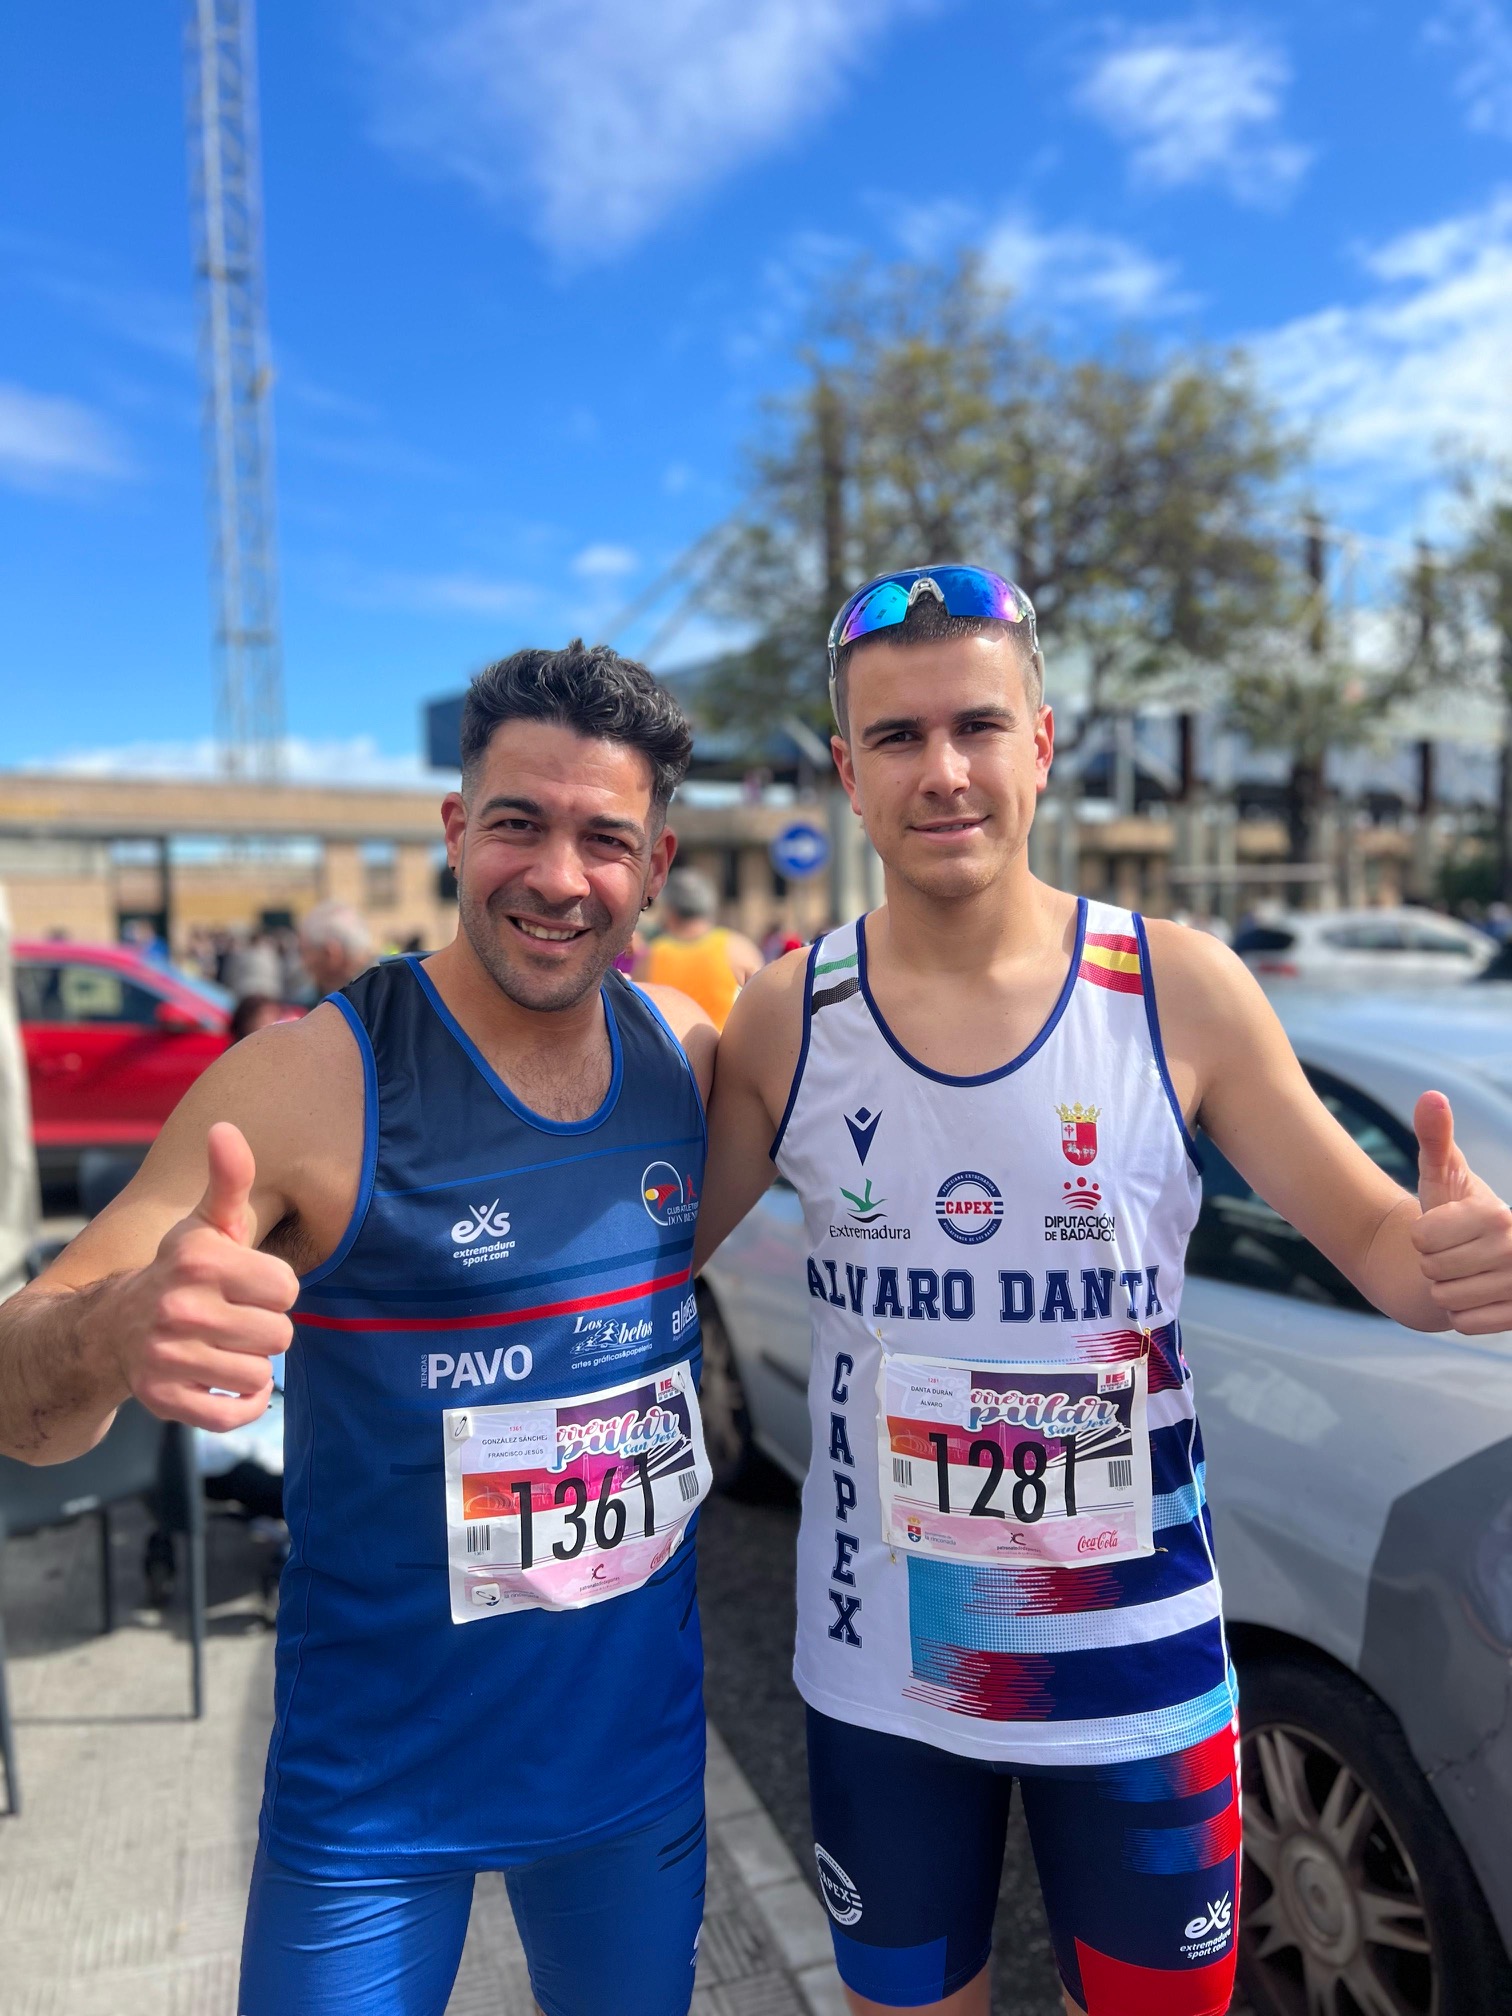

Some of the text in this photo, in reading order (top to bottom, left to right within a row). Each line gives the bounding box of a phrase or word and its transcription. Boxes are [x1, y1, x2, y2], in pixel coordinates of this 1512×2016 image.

[945, 1201, 994, 1215] CAPEX
[1044, 1212, 1115, 1229] DIPUTACIÓN
[829, 1224, 911, 1240] Extremadura
[1044, 1231, 1057, 1241] DE
[453, 1240, 516, 1259] extremadura
[462, 1250, 510, 1268] sport.com
[998, 1265, 1164, 1323] DANTA
[572, 1316, 603, 1334] Los
[420, 1345, 533, 1390] TIENDAS PAVO
[571, 1360, 592, 1370] artes
[910, 1385, 954, 1397] DANTA DURÁN
[920, 1399, 943, 1408] ÁLVARO
[1047, 1425, 1077, 1436] San
[481, 1436, 517, 1446] GONZÁLEZ
[623, 1443, 647, 1455] San
[488, 1448, 544, 1459] FRANCISCO JESÚS
[929, 1432, 1077, 1523] 1281
[511, 1455, 655, 1571] 1361
[1180, 1928, 1231, 1952] extremadura
[1187, 1940, 1227, 1960] sport.com
